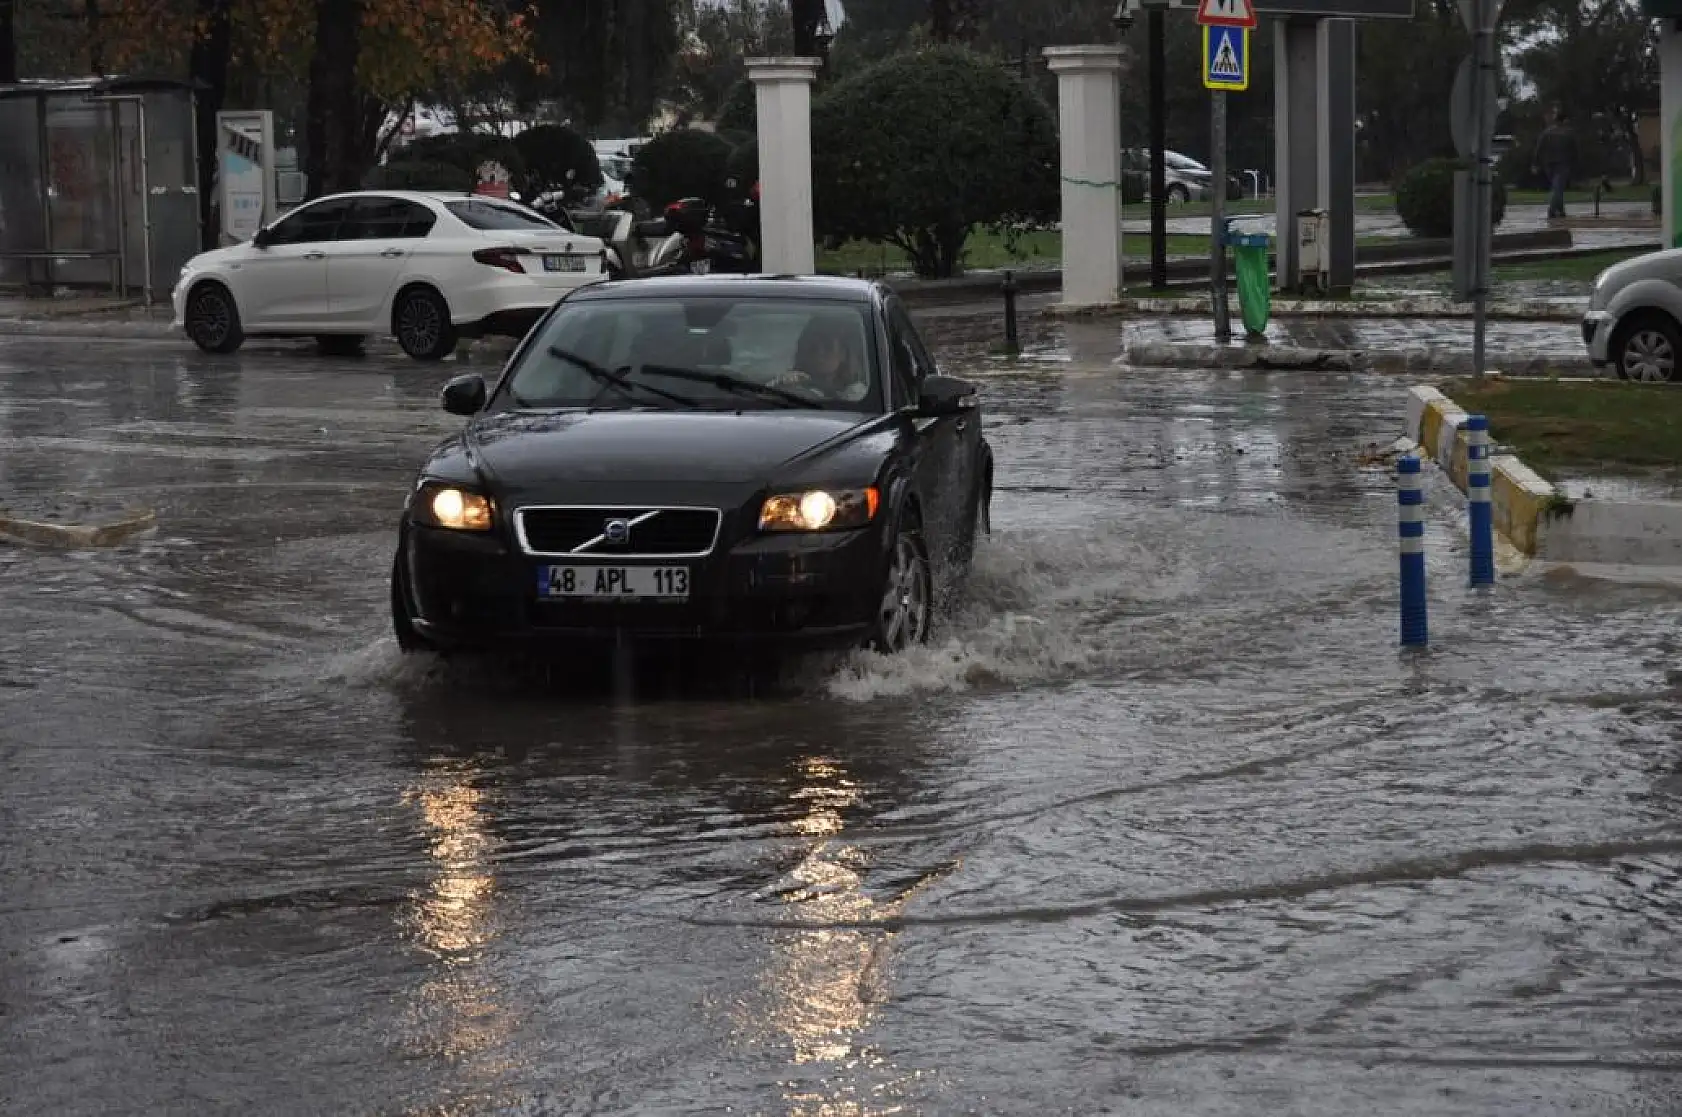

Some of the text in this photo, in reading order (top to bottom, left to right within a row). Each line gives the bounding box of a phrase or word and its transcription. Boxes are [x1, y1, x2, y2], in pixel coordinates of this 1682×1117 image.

[550, 567, 576, 592] 48
[594, 567, 635, 594] APL
[653, 568, 688, 594] 113
